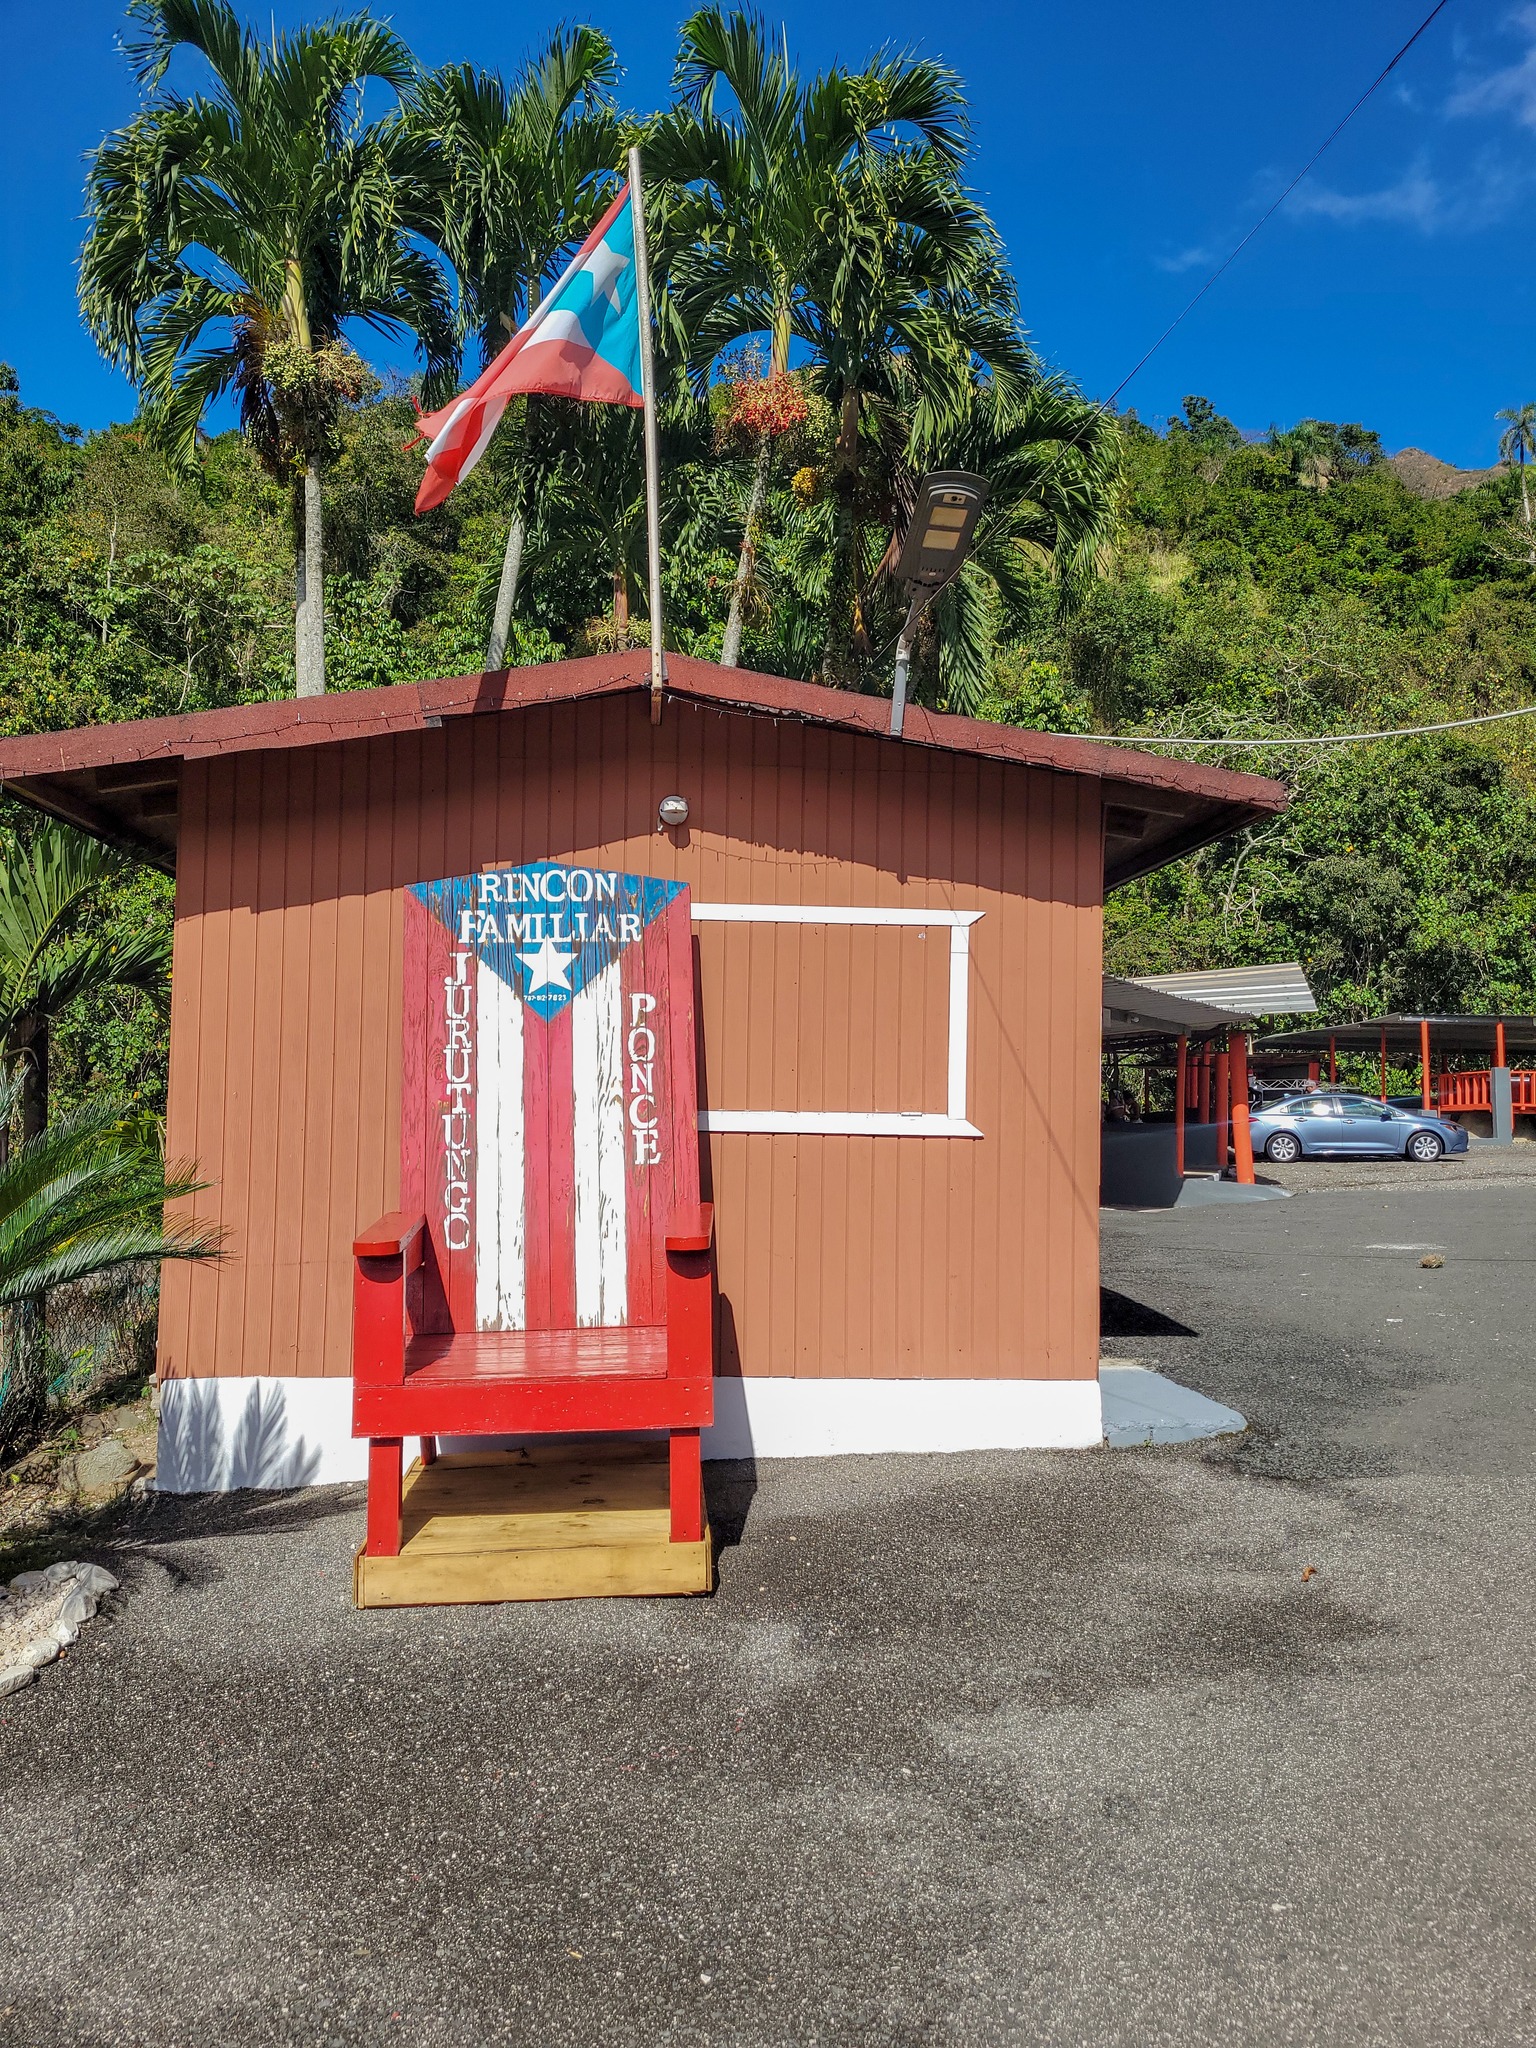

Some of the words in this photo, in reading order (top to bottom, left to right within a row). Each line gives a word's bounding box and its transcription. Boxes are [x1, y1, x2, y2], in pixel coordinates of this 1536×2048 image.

[458, 909, 642, 944] FAMILIAR
[477, 869, 617, 903] RINCON
[442, 952, 472, 1249] JURUTUNGO
[627, 993, 661, 1165] PONCE
